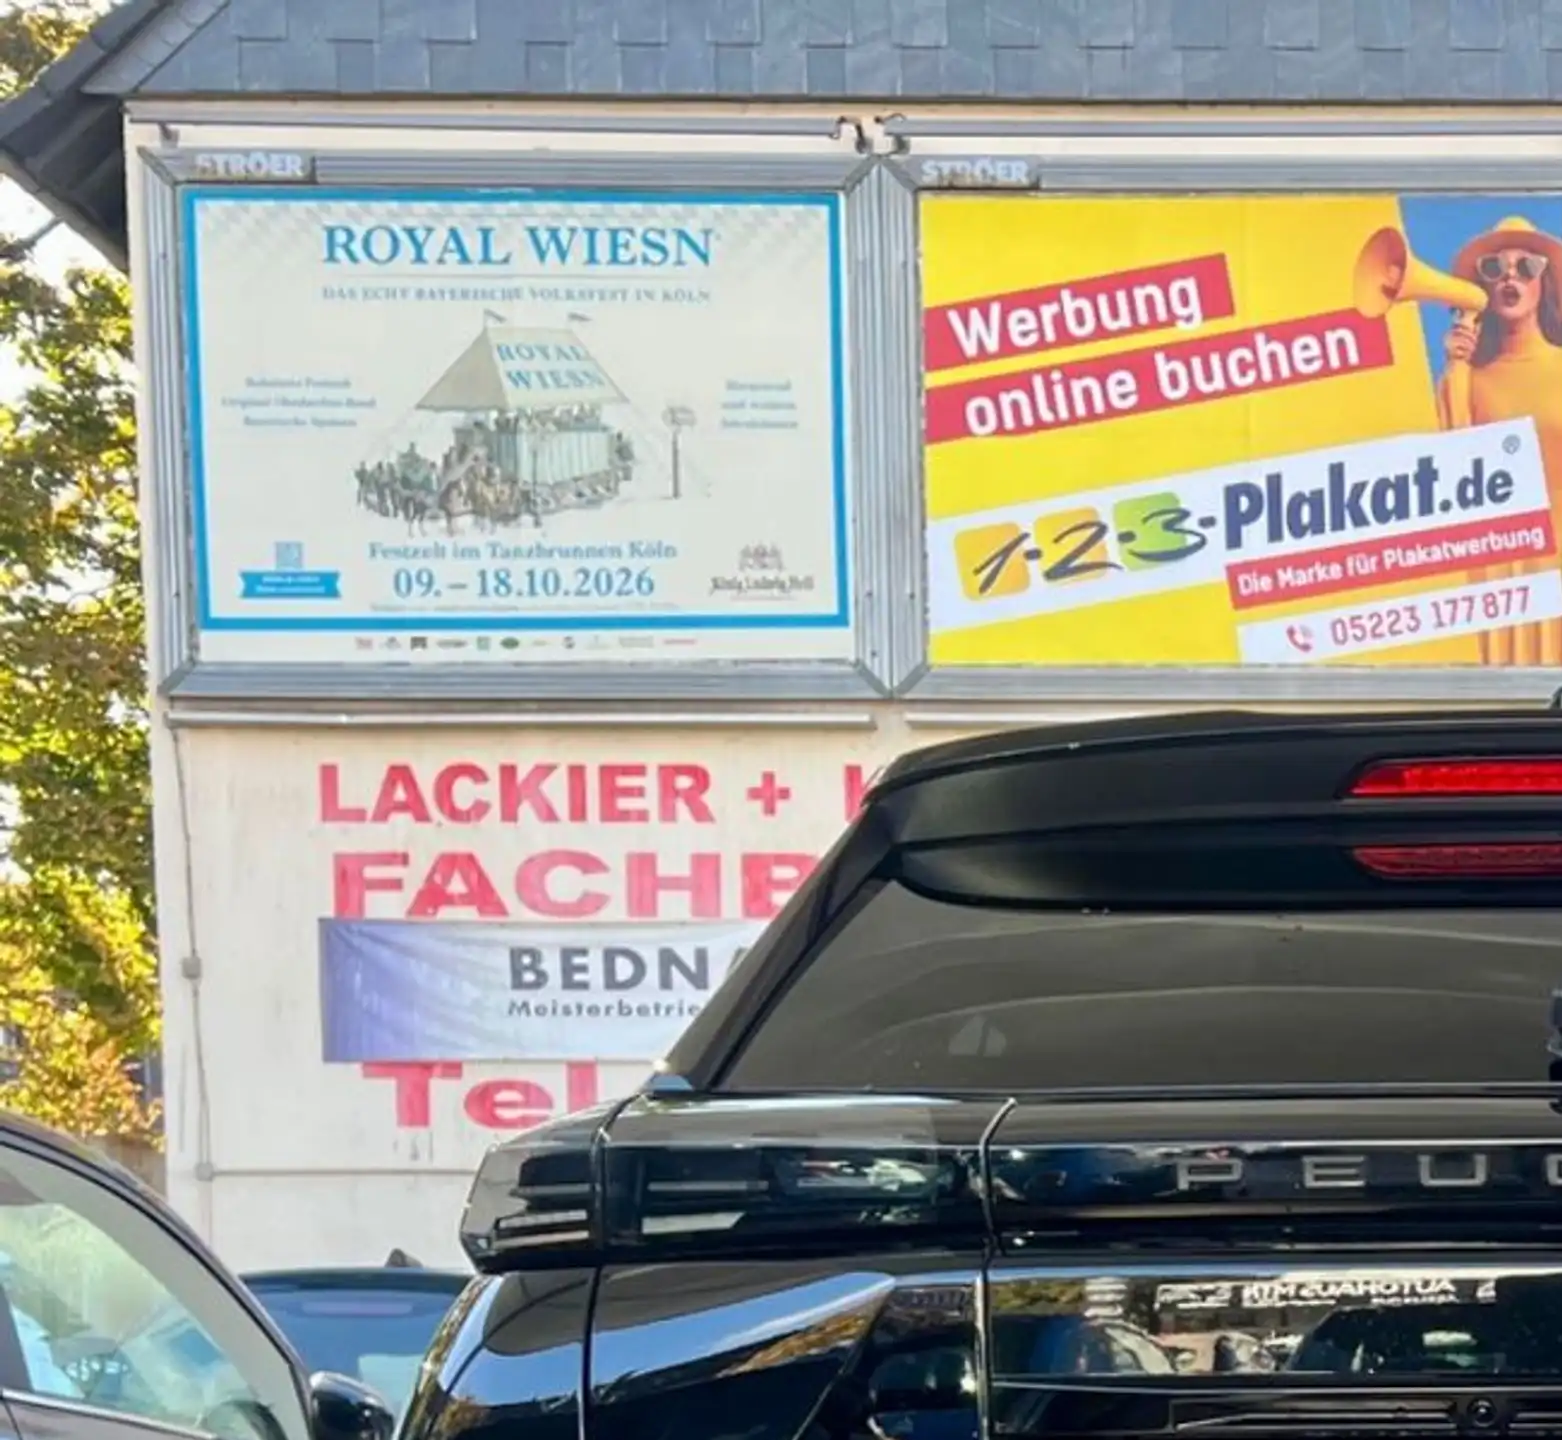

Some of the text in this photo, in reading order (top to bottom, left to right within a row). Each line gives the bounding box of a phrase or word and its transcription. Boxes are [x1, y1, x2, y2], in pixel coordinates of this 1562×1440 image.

[322, 225, 713, 267] ROYAL WIESN
[948, 275, 1202, 362] Werbung
[497, 344, 589, 362] ROYAL
[506, 368, 606, 391] WIESN
[965, 324, 1360, 440] online buchen
[369, 539, 678, 561] Festzelt im Tanzbrunnen Köln
[1237, 522, 1546, 598] Die Marke für Plakatwerbung
[1331, 586, 1532, 645] 05223 177 877
[319, 763, 713, 823] LACKIER
[508, 946, 748, 991] BEDN
